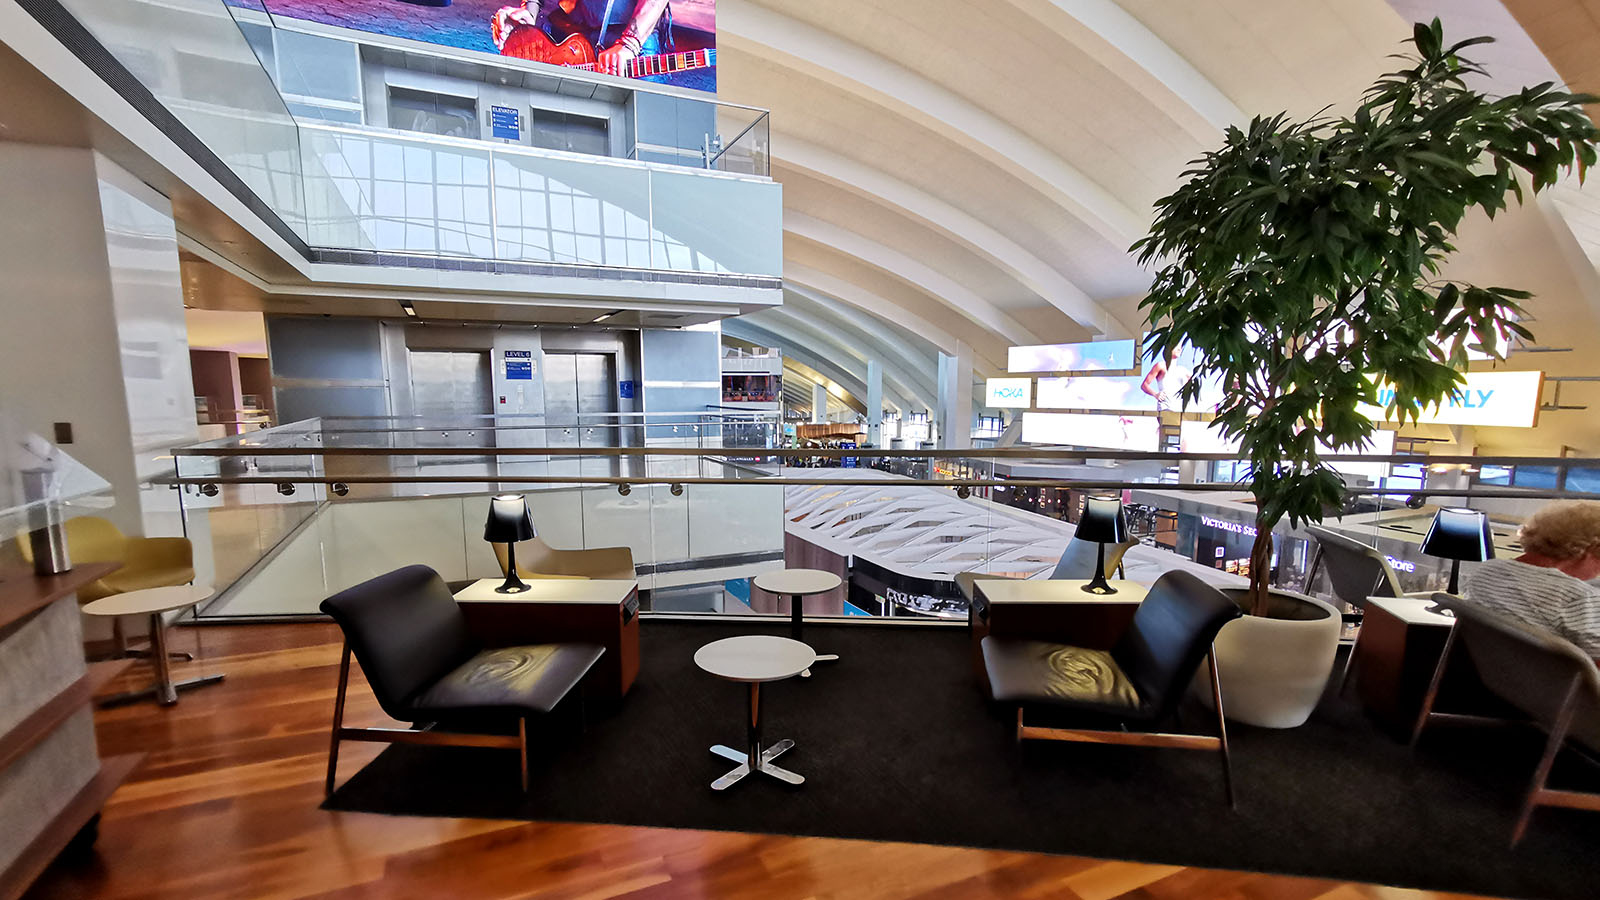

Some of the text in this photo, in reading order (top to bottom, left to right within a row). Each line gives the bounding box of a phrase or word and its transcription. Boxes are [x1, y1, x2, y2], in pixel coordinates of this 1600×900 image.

[492, 107, 518, 115] ELEVATOR
[993, 387, 1023, 398] HOKA
[1449, 389, 1495, 408] FLY
[1201, 515, 1258, 537] VICTORIA'S SEC
